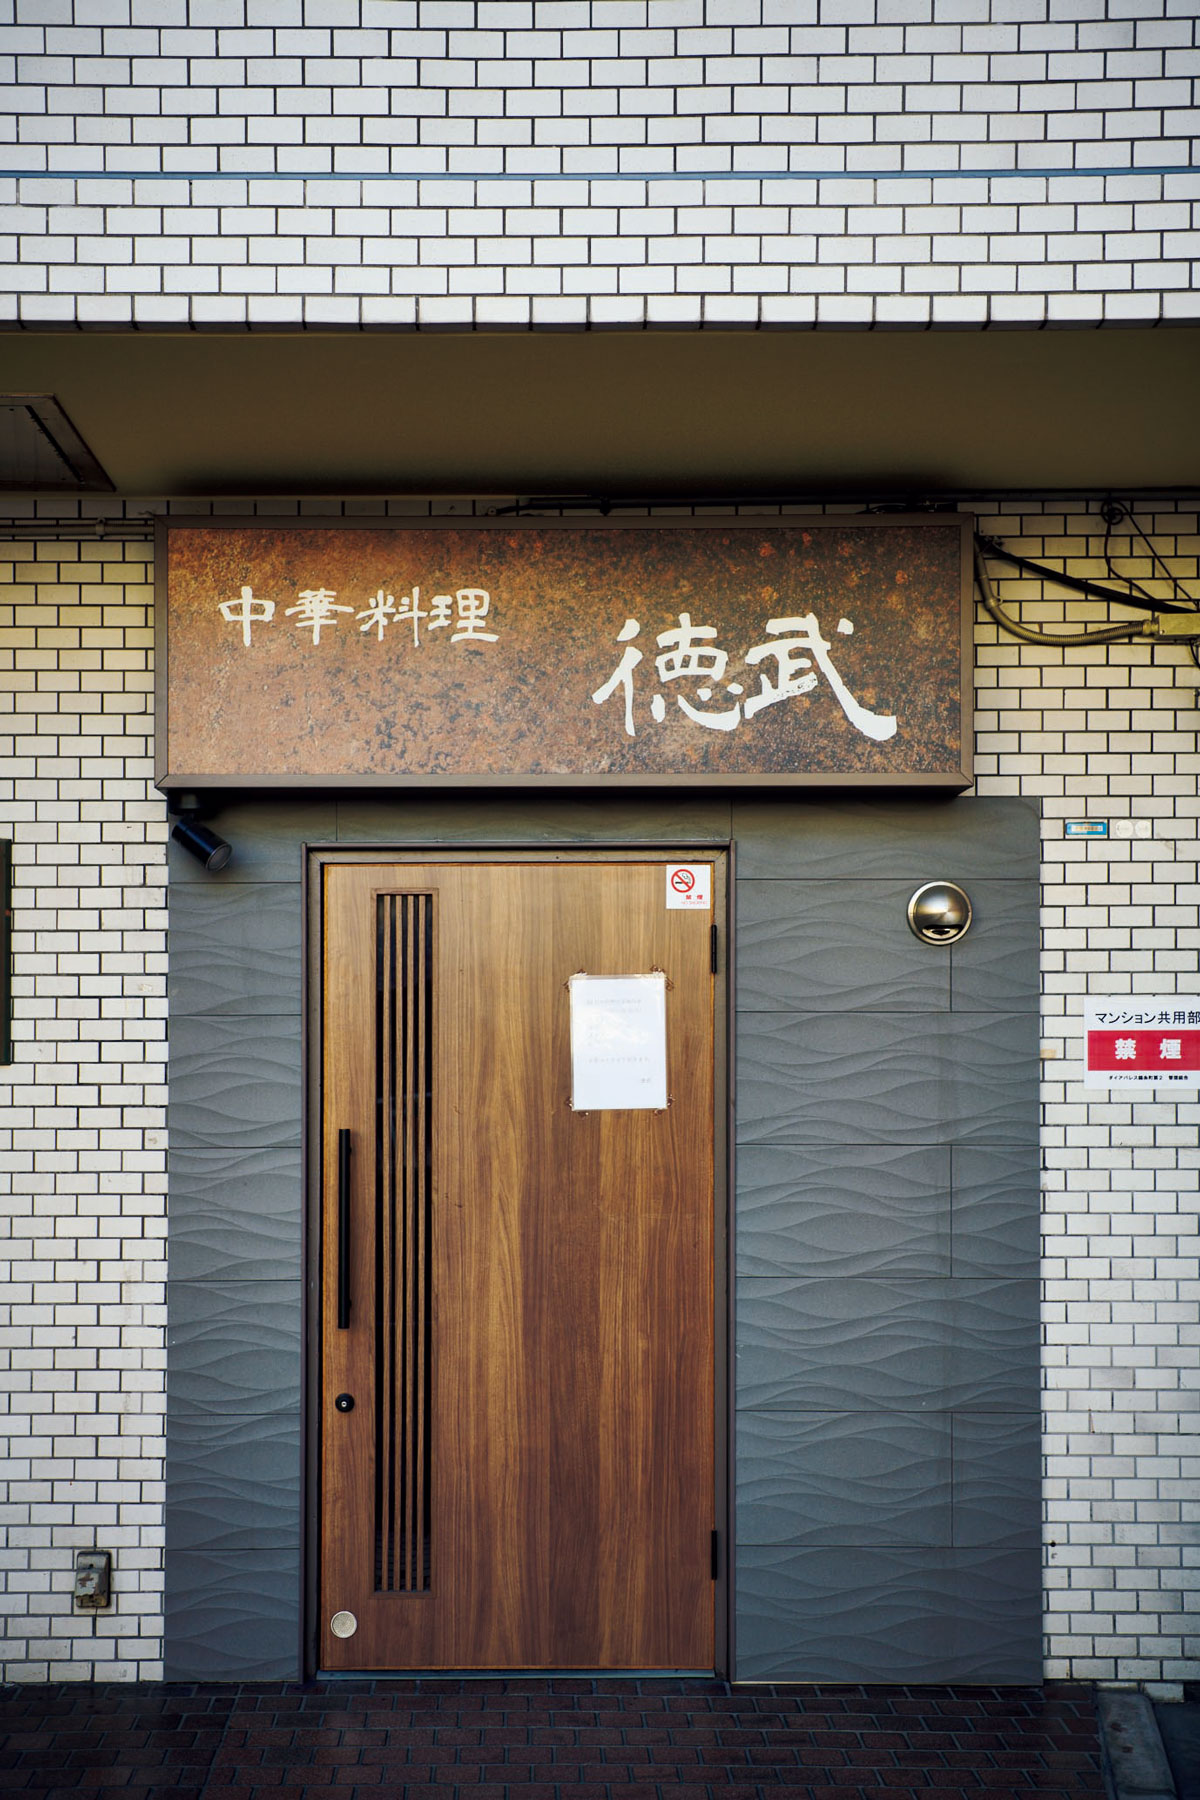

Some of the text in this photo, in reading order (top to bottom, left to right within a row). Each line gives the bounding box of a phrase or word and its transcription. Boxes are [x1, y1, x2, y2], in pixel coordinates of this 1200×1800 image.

[218, 585, 499, 648] 中華料理
[592, 612, 897, 741] 徳武
[1095, 1011, 1200, 1025] マンション共用部
